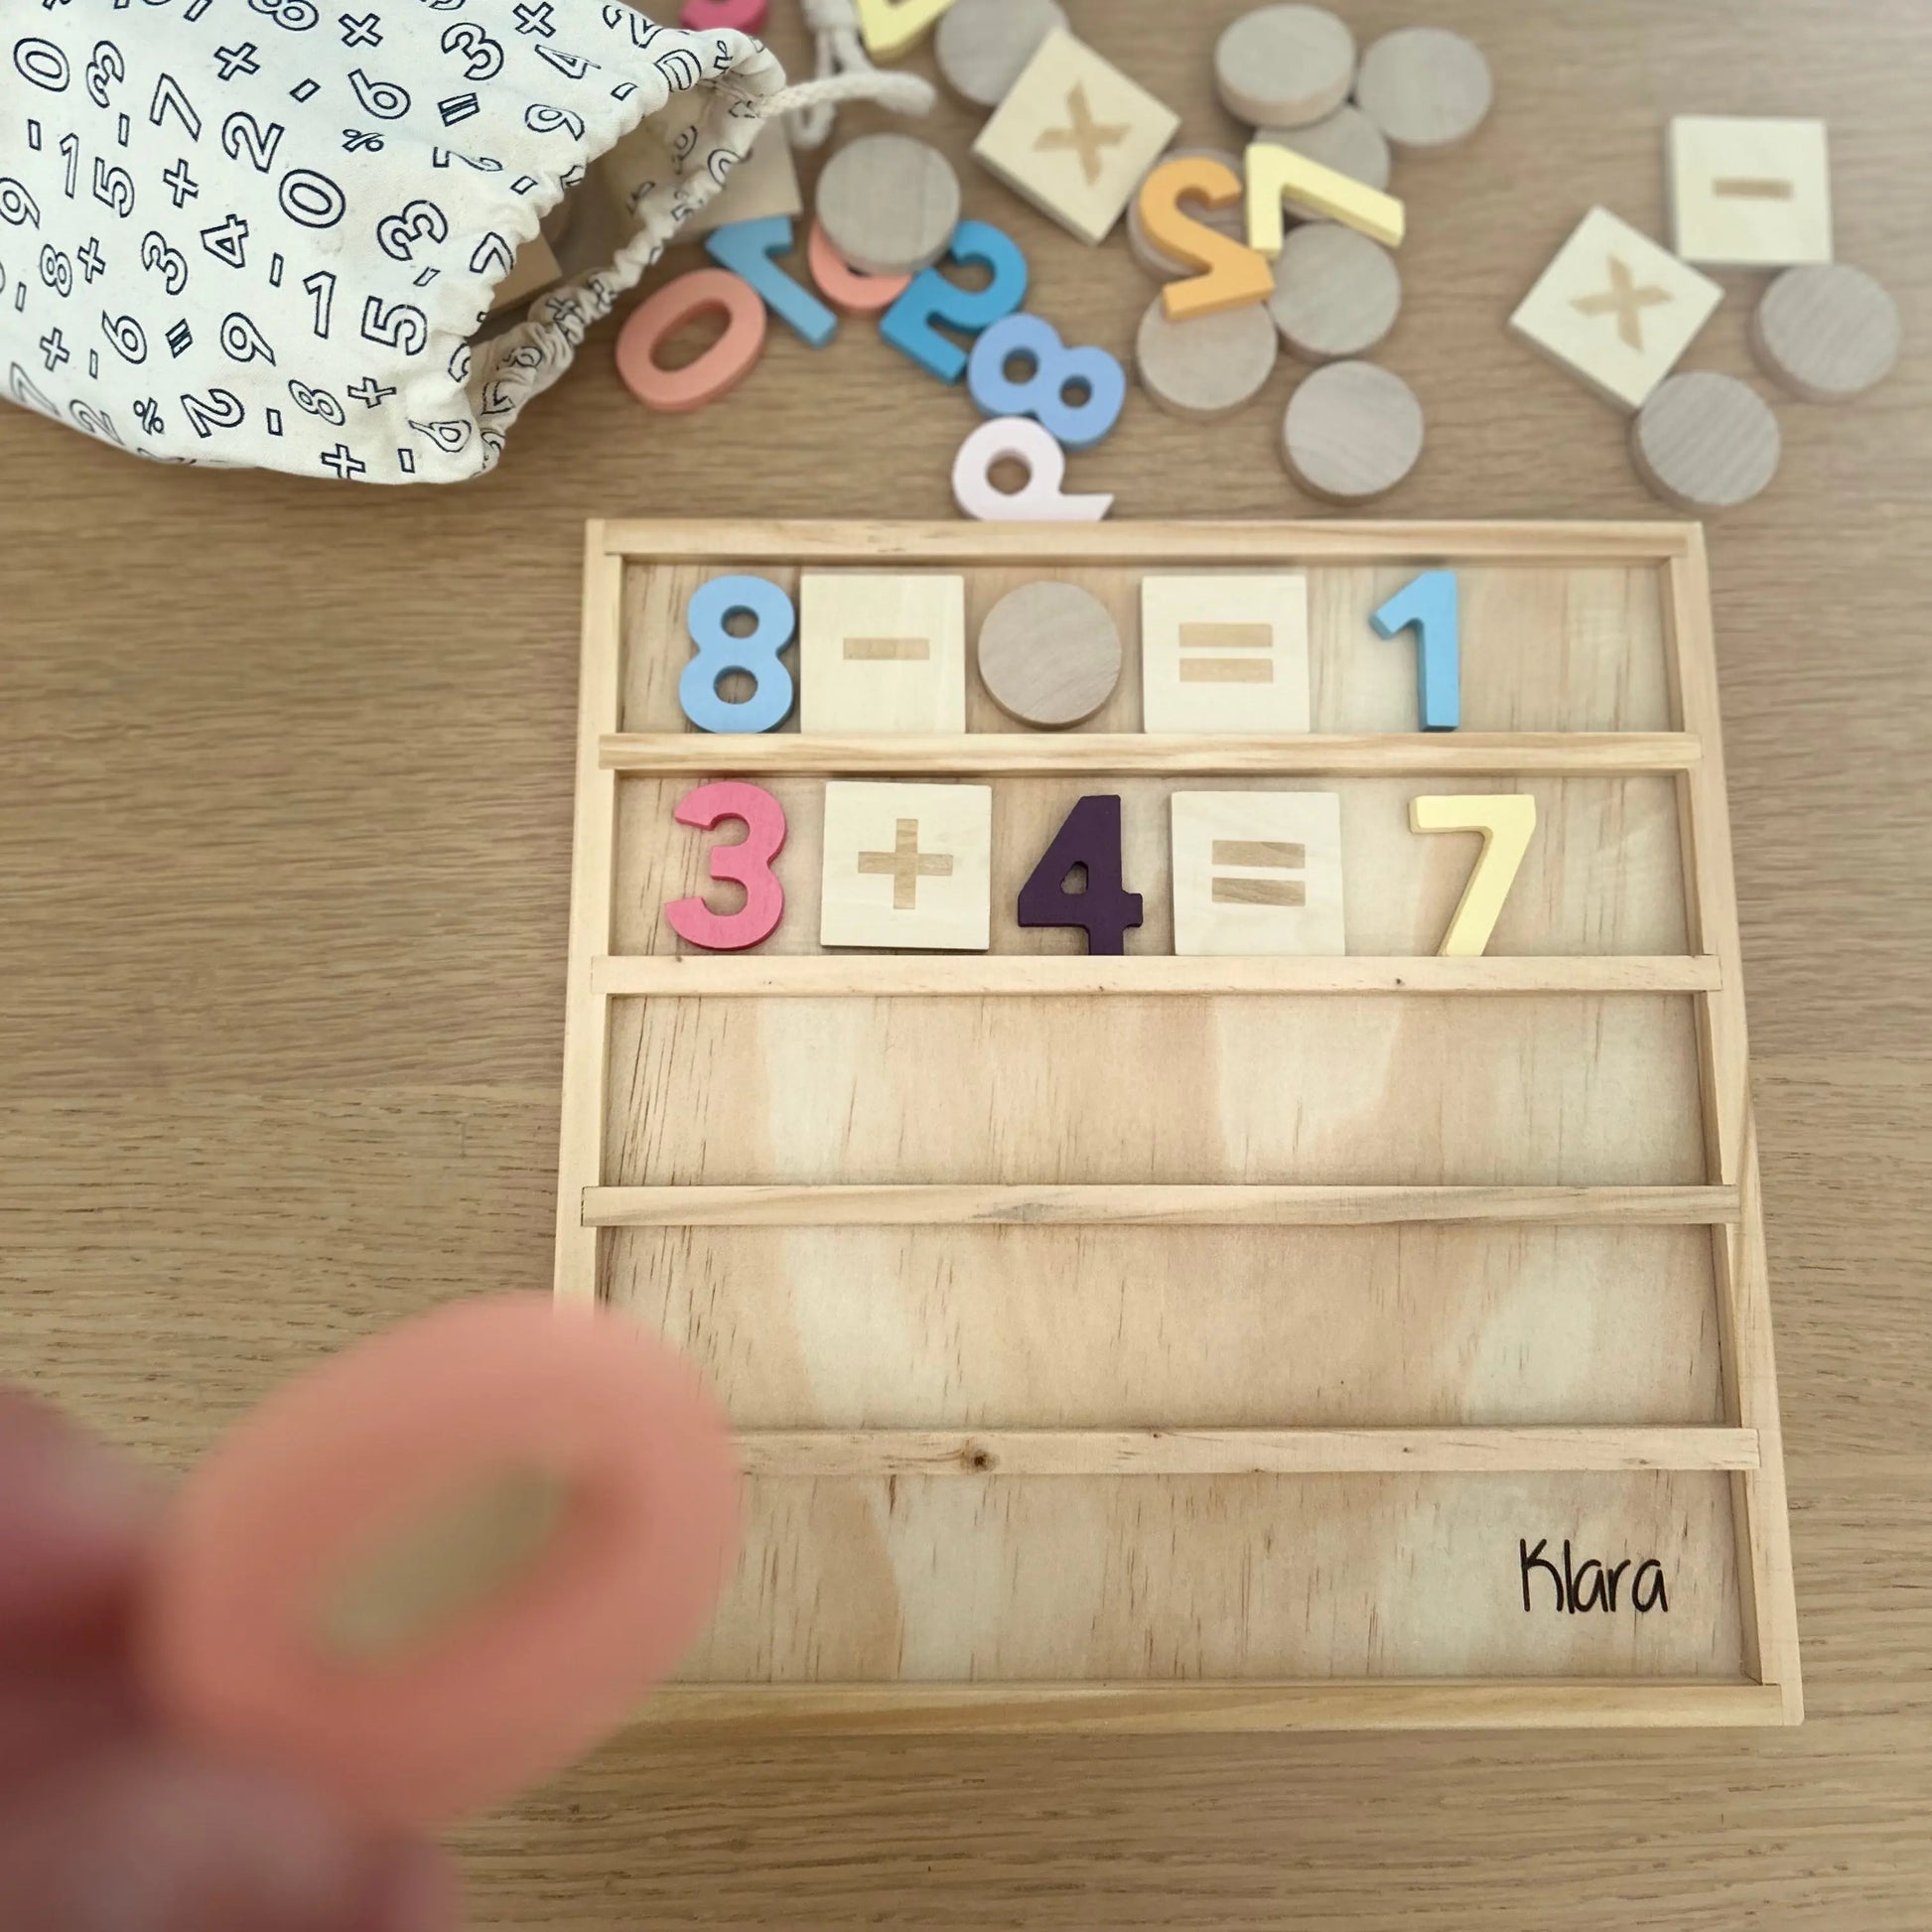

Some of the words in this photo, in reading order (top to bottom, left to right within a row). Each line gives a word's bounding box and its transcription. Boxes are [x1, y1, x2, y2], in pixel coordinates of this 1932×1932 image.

[441, 22, 504, 81] 3
[149, 72, 203, 143] 7
[60, 132, 79, 199] 1
[221, 111, 285, 174] 2
[93, 156, 135, 218] 5
[279, 169, 346, 228] 0
[200, 213, 249, 268] 4
[376, 199, 449, 261] 3
[40, 244, 72, 297] 8
[141, 231, 189, 296] 3
[303, 270, 337, 340] 1
[360, 295, 428, 356] 5
[967, 313, 1126, 451] 8
[679, 575, 795, 734] 8
[1369, 570, 1460, 732] 1
[665, 781, 786, 950] 3
[1018, 794, 1143, 956] 4
[1408, 794, 1537, 956] 7
[1520, 1538, 1669, 1614] Klara
